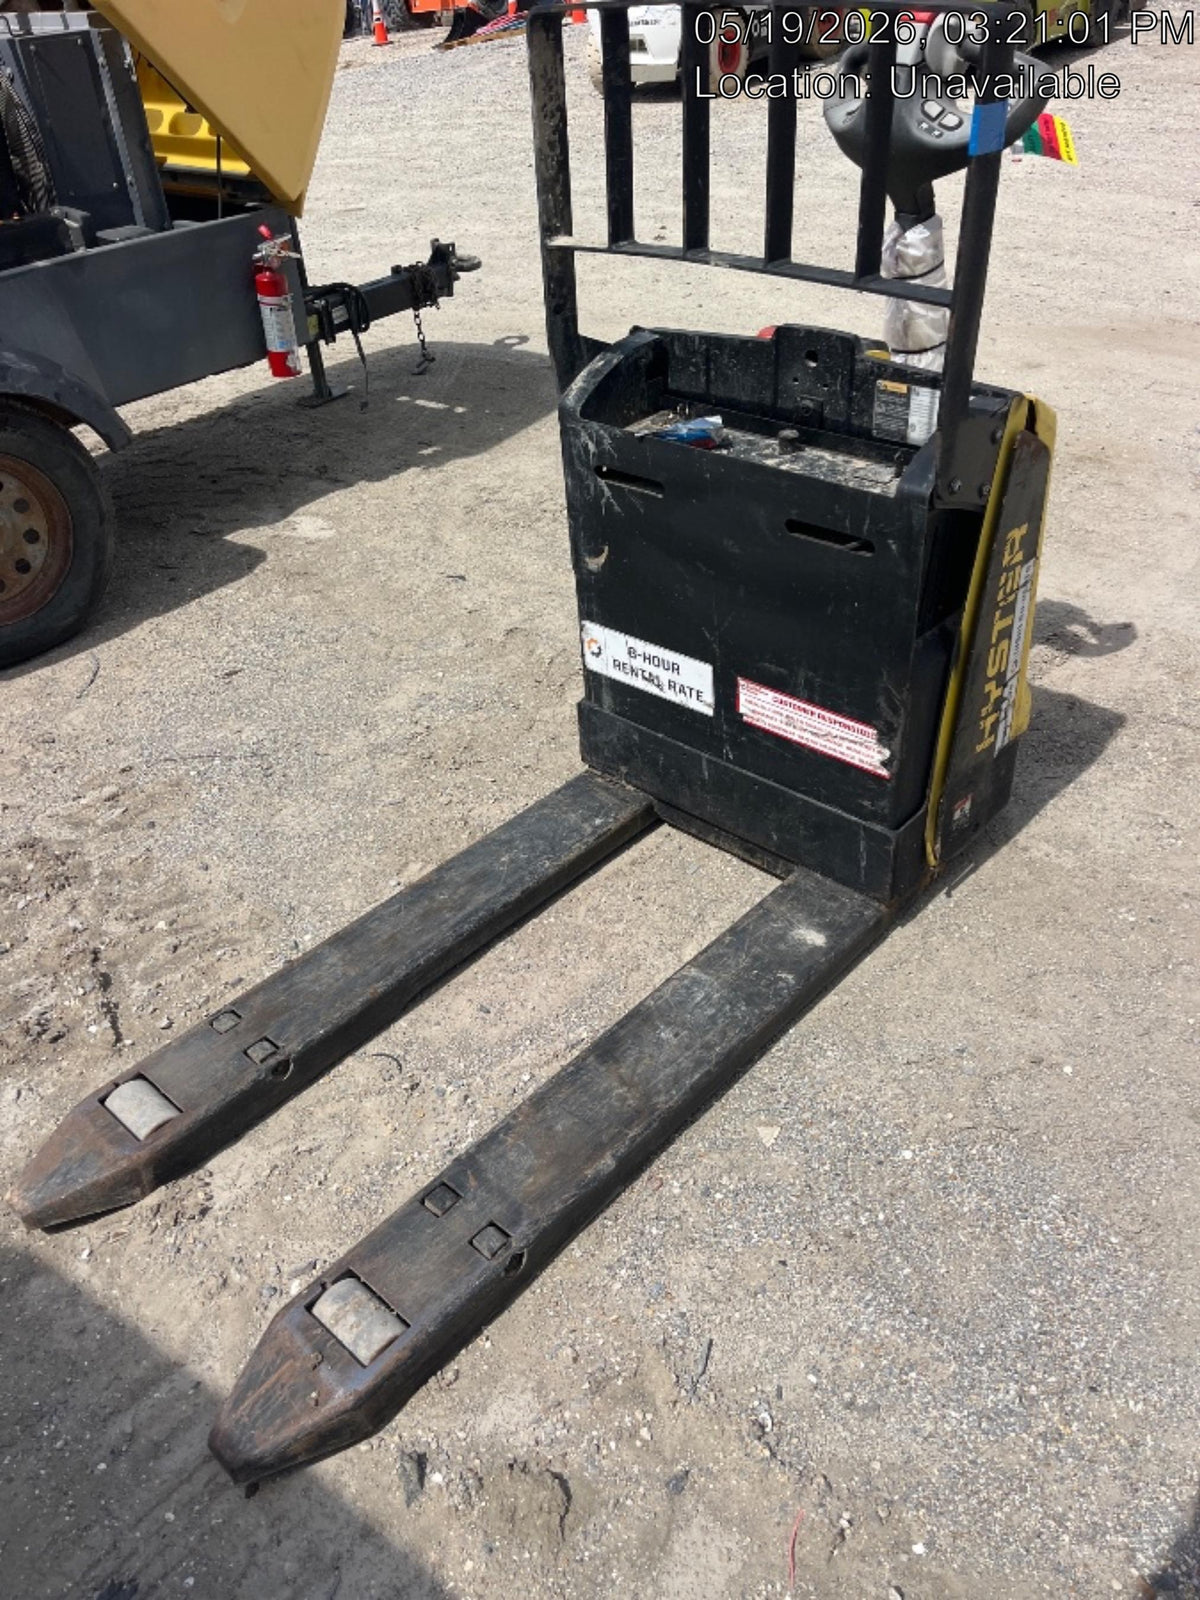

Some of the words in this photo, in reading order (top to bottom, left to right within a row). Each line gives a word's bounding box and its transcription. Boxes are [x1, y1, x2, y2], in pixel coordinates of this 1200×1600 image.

[612, 658, 663, 690] RENTAL
[667, 678, 704, 703] RATE
[975, 522, 1028, 753] HYSTER
